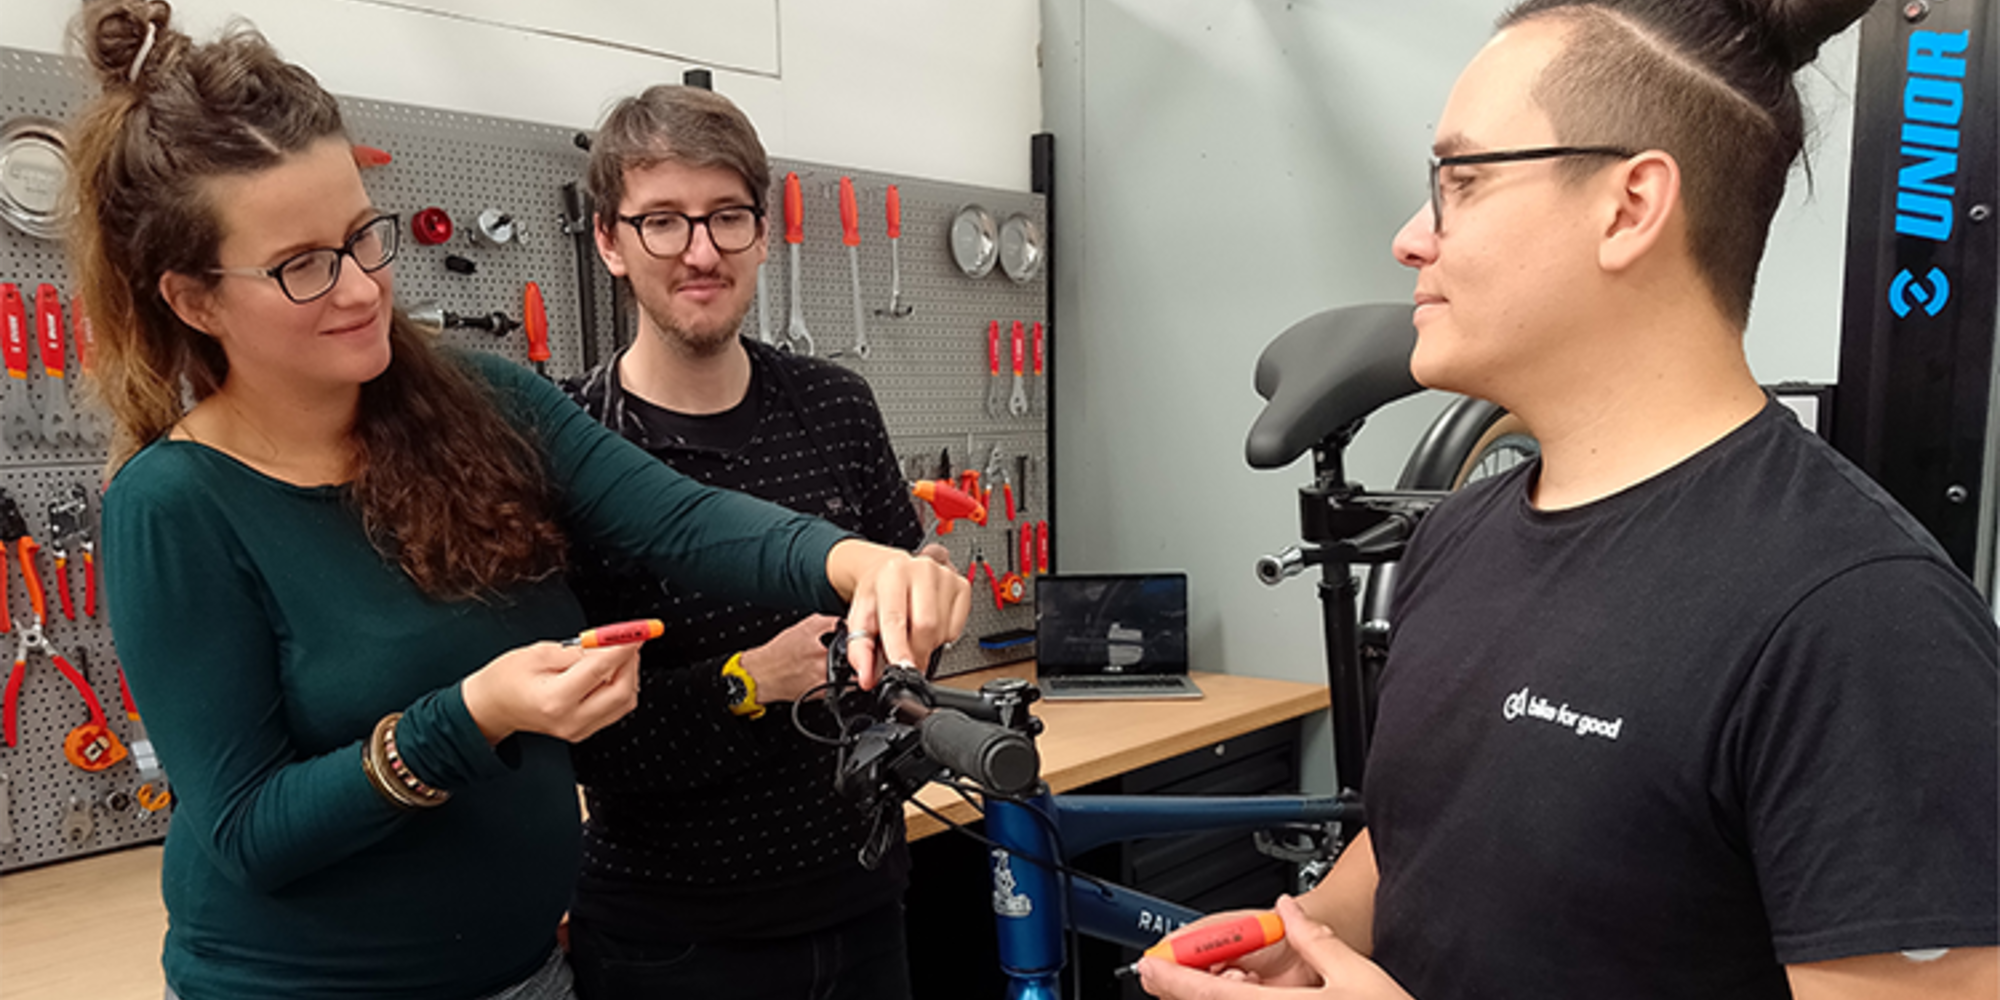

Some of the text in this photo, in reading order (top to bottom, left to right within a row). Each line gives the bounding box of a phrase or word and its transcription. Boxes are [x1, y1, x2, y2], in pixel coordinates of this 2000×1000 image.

[1895, 29, 1970, 241] UNIOR
[1527, 696, 1622, 739] bike for good
